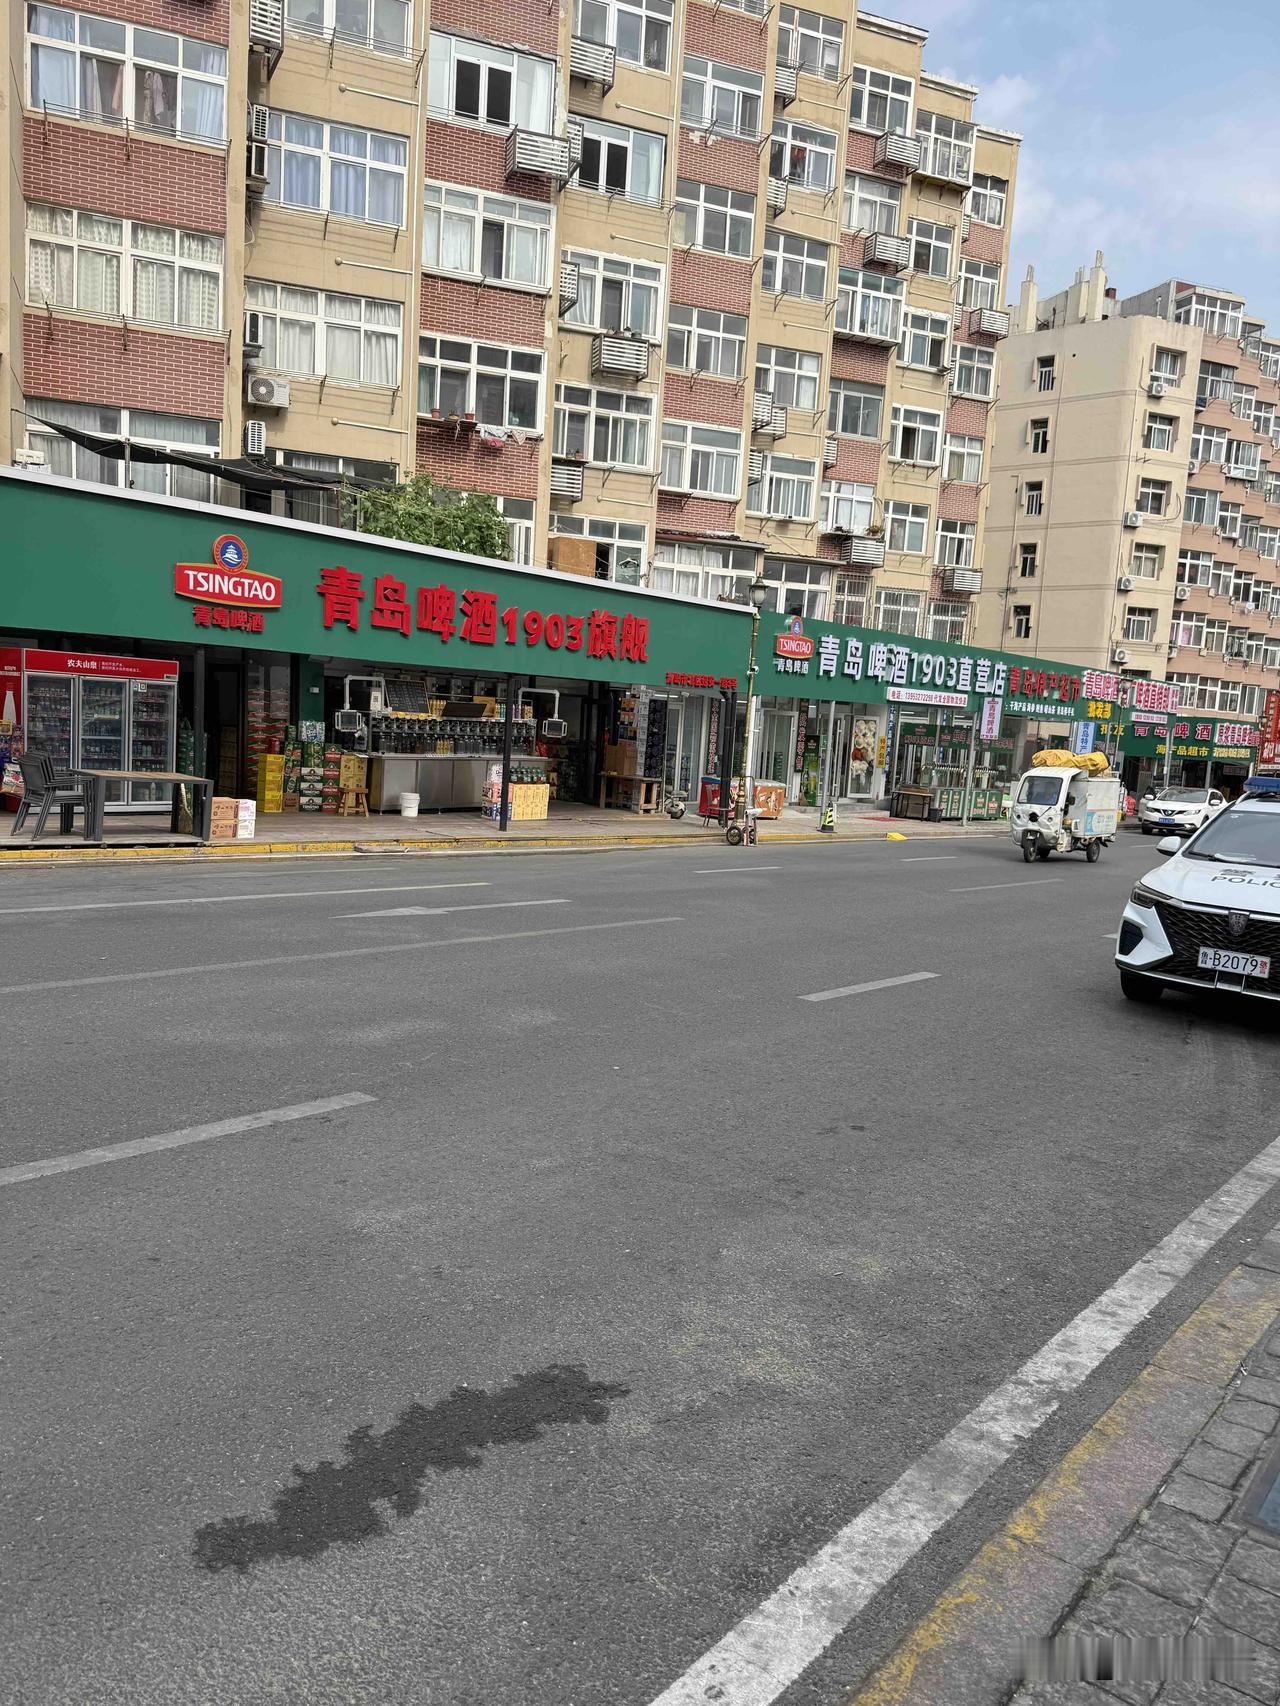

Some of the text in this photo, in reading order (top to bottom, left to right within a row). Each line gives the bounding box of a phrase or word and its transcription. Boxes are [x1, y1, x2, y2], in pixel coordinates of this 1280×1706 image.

[184, 569, 276, 602] TSINGTAO
[192, 605, 265, 633] 青岛啤酒
[317, 566, 650, 663] 青岛啤酒1903旗舰
[779, 637, 811, 655] TSINGTAO
[67, 659, 98, 669] 农夫山泉
[818, 635, 1008, 695] 青岛啤酒1903直营店
[1009, 667, 1081, 702] 青岛特产超市
